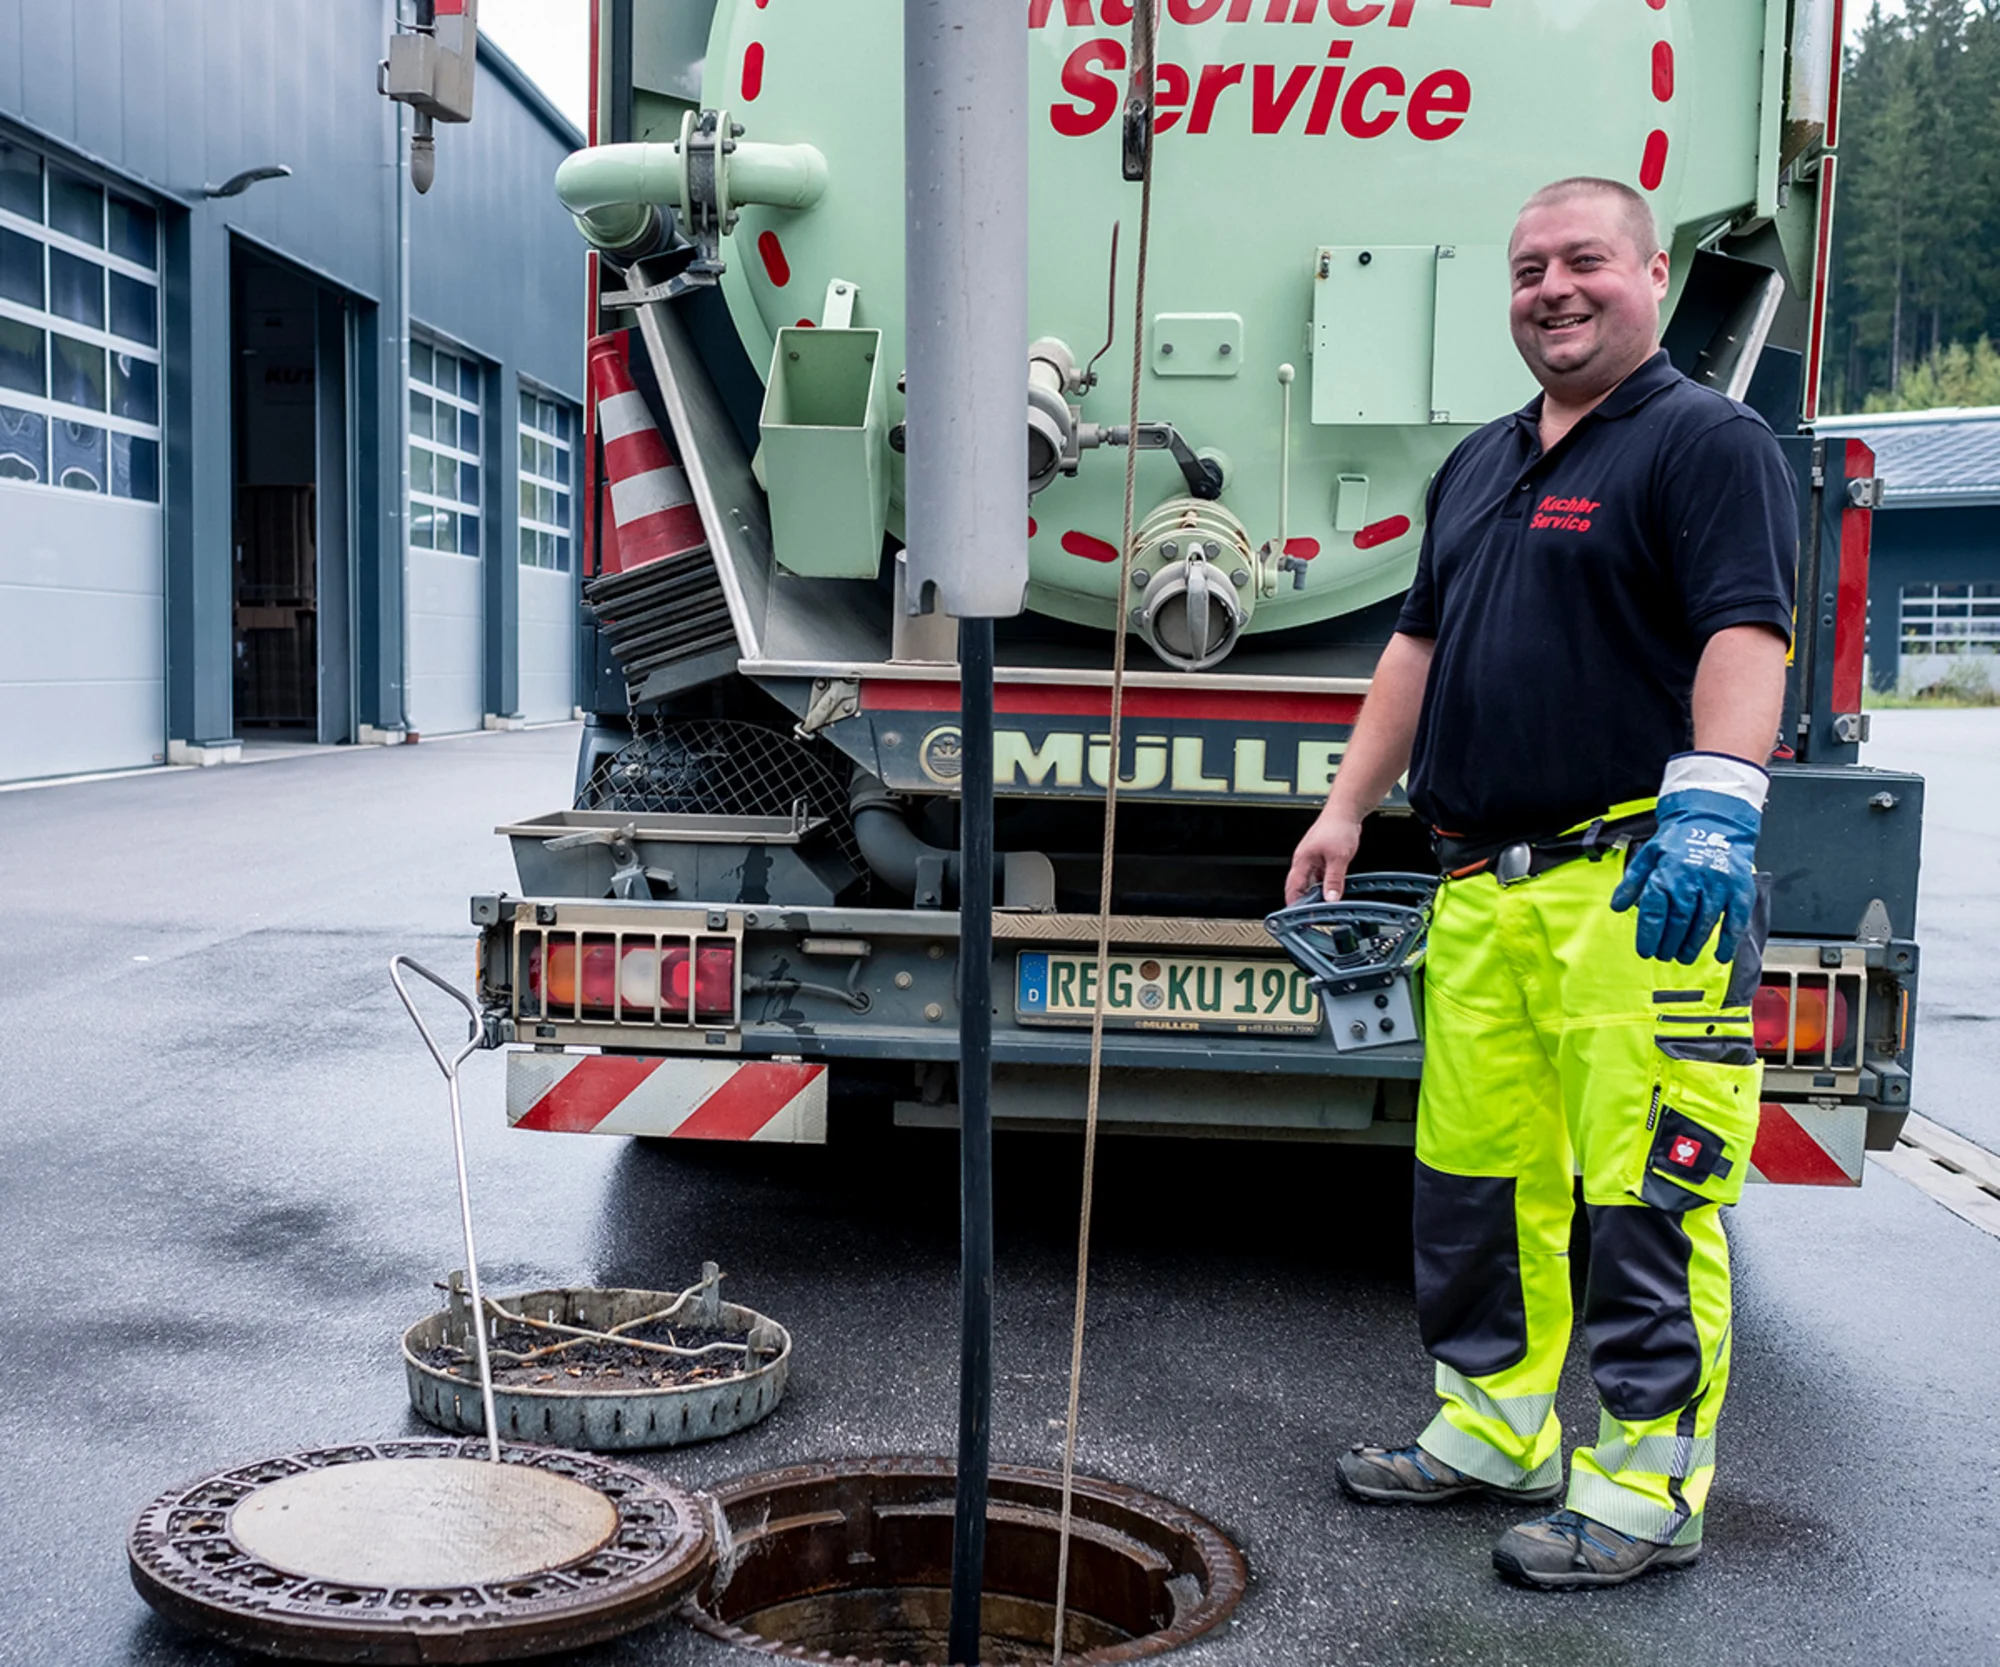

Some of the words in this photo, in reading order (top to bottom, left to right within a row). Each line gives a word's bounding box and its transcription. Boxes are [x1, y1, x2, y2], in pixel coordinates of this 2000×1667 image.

[1050, 38, 1472, 141] Service
[1529, 512, 1591, 532] Service
[992, 730, 1408, 797] MÜLLE
[1028, 988, 1039, 1002] D
[1050, 961, 1133, 1008] REG
[1168, 965, 1222, 1013] KU
[1233, 967, 1313, 1016] 190
